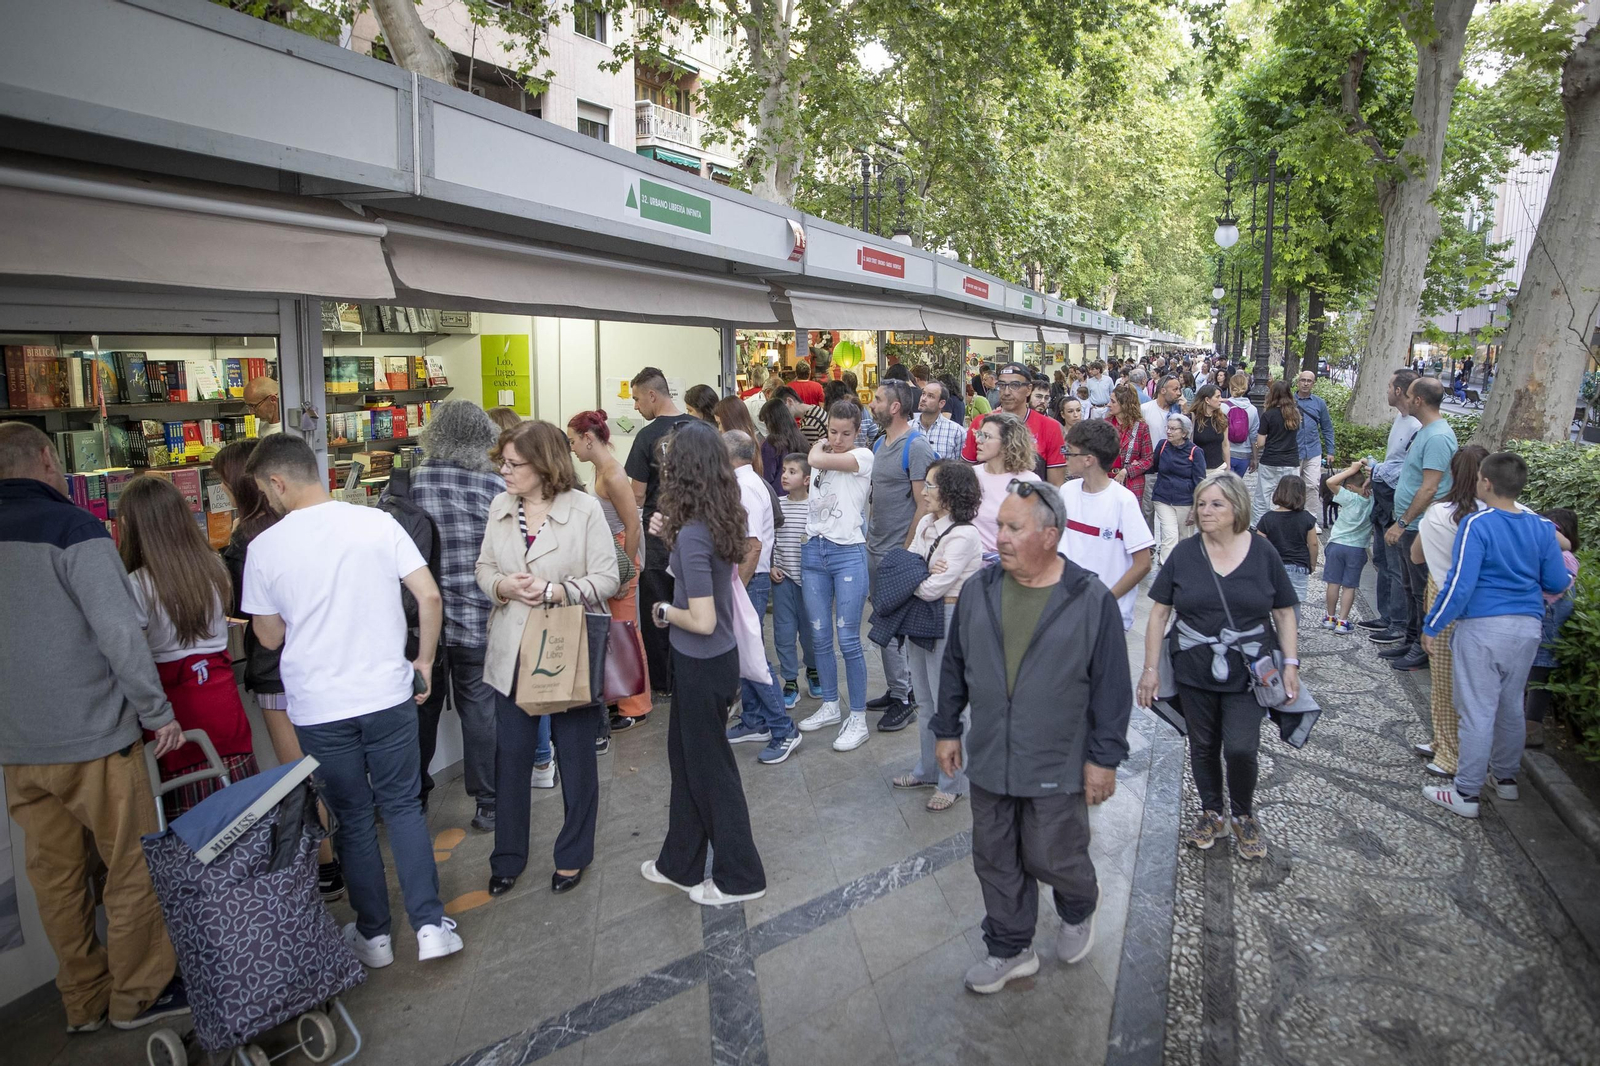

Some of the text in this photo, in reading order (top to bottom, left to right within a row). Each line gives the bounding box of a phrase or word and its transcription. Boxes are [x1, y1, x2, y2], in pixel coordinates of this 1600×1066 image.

[641, 194, 702, 219] 32. URBANO LIBRERÍA INFINITA
[496, 356, 513, 367] Leo,
[495, 367, 516, 379] luego
[548, 635, 565, 645] Casa
[546, 651, 563, 660] Libro
